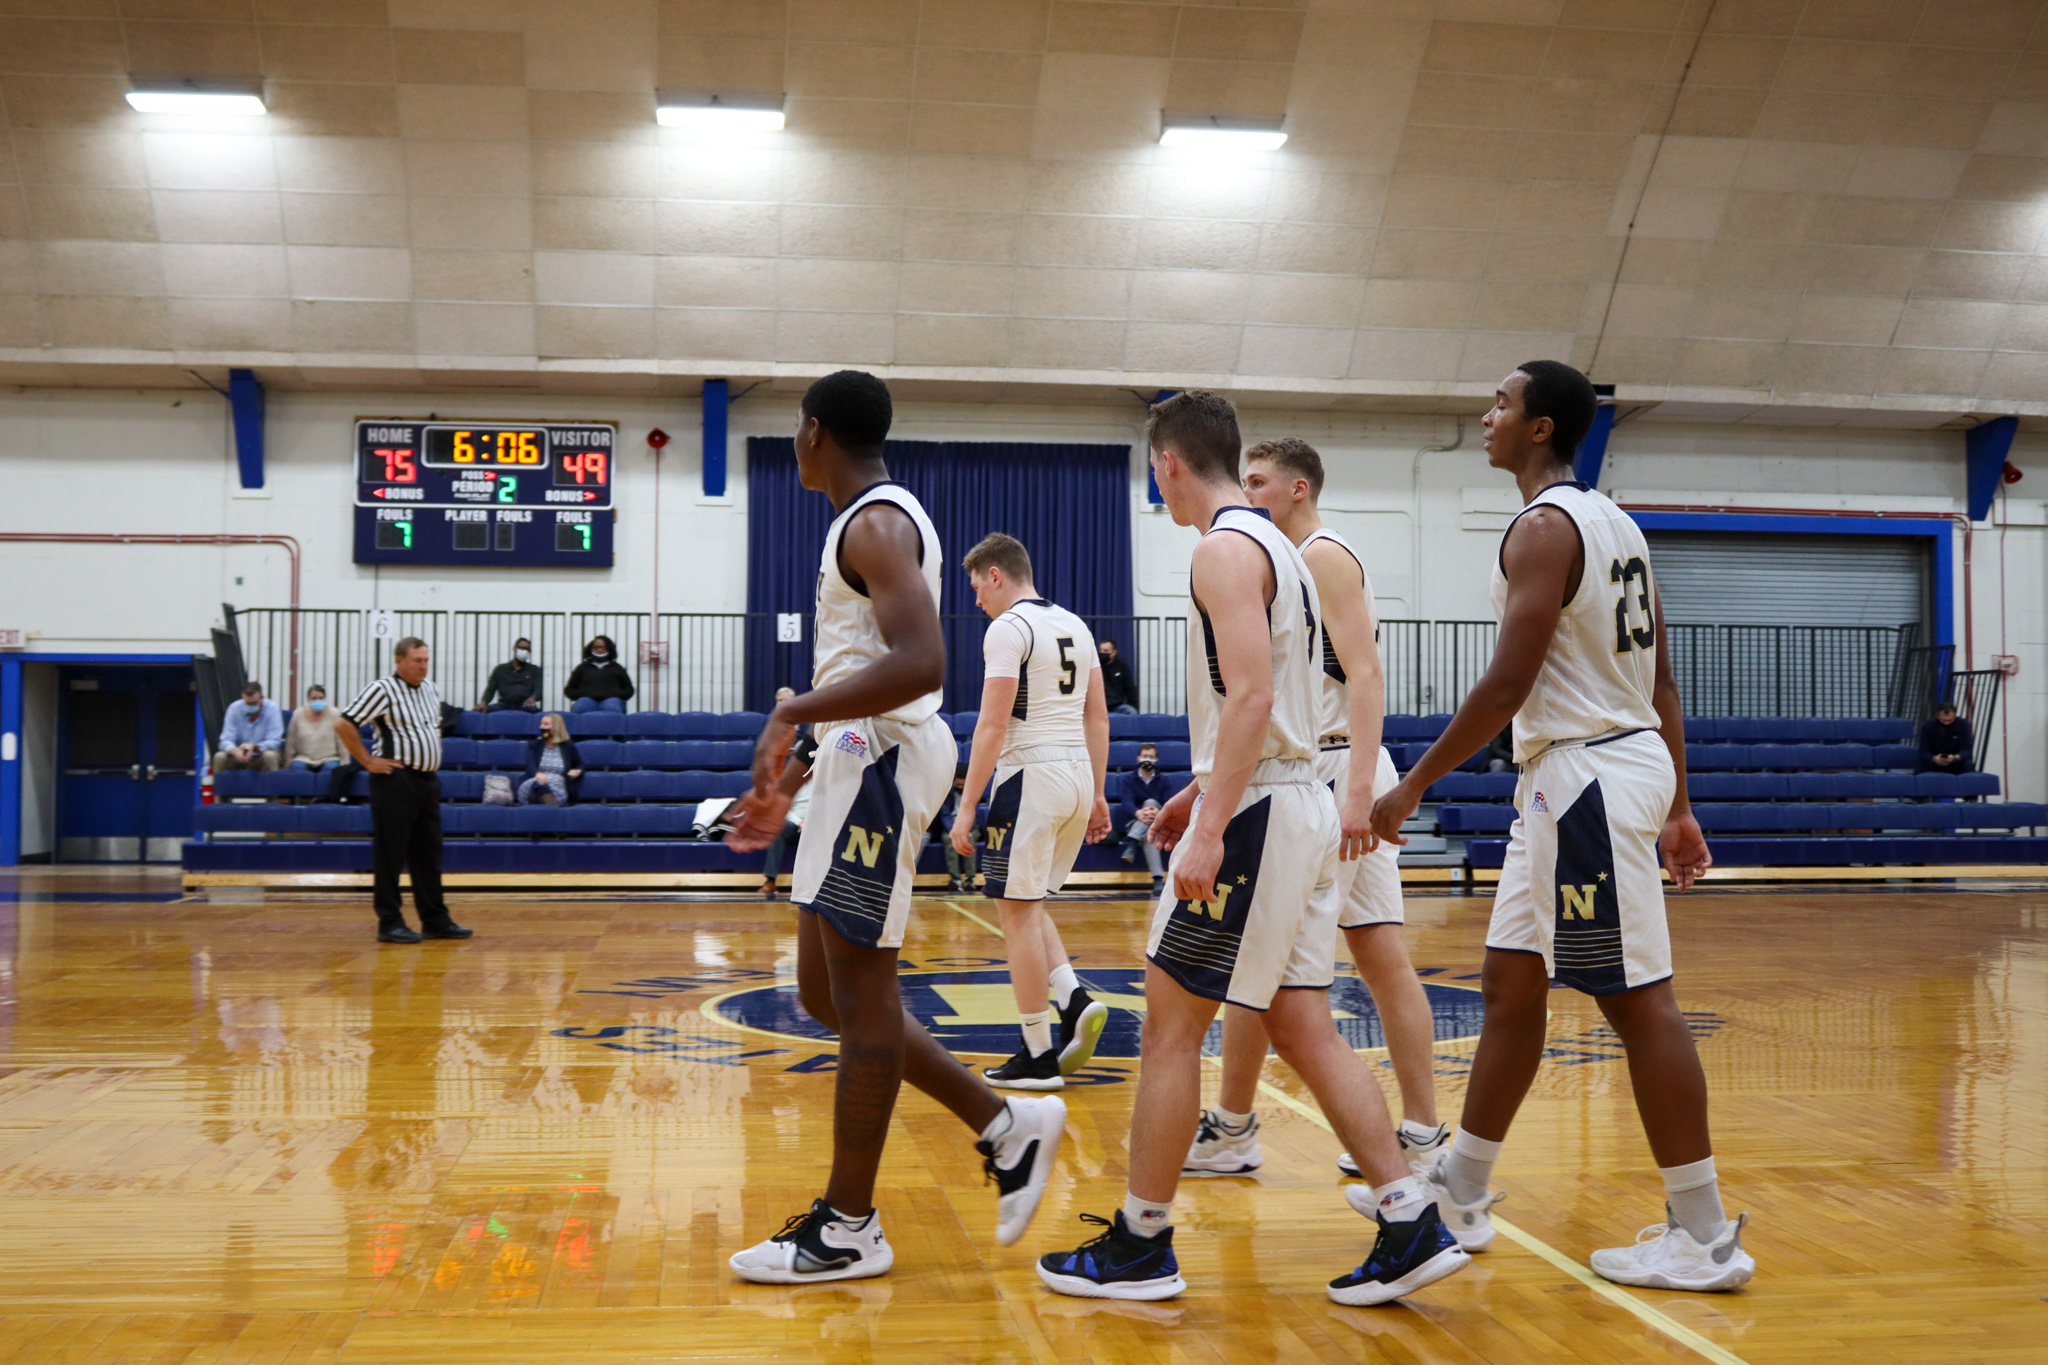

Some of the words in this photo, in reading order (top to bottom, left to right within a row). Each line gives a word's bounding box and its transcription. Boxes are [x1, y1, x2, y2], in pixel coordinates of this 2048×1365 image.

[367, 428, 413, 443] HOME
[453, 431, 539, 463] 6:06
[551, 431, 610, 446] VISITOR
[373, 449, 416, 481] 75
[563, 453, 606, 485] 49
[385, 488, 424, 500] BONUS
[451, 480, 494, 492] PERIOD
[498, 476, 517, 502] 2
[545, 490, 583, 502] BONUS
[376, 508, 414, 521] FOULS
[445, 509, 488, 522] PLAYER
[496, 510, 532, 522] FOULS
[556, 511, 592, 523] FOULS
[394, 521, 412, 547] 7
[574, 524, 591, 550] 7
[1609, 555, 1655, 655] 23
[376, 617, 388, 636] 6
[783, 621, 795, 640] 5
[1056, 636, 1077, 696] 5
[841, 825, 885, 869] N
[986, 826, 1008, 851] N
[1560, 884, 1598, 920] N
